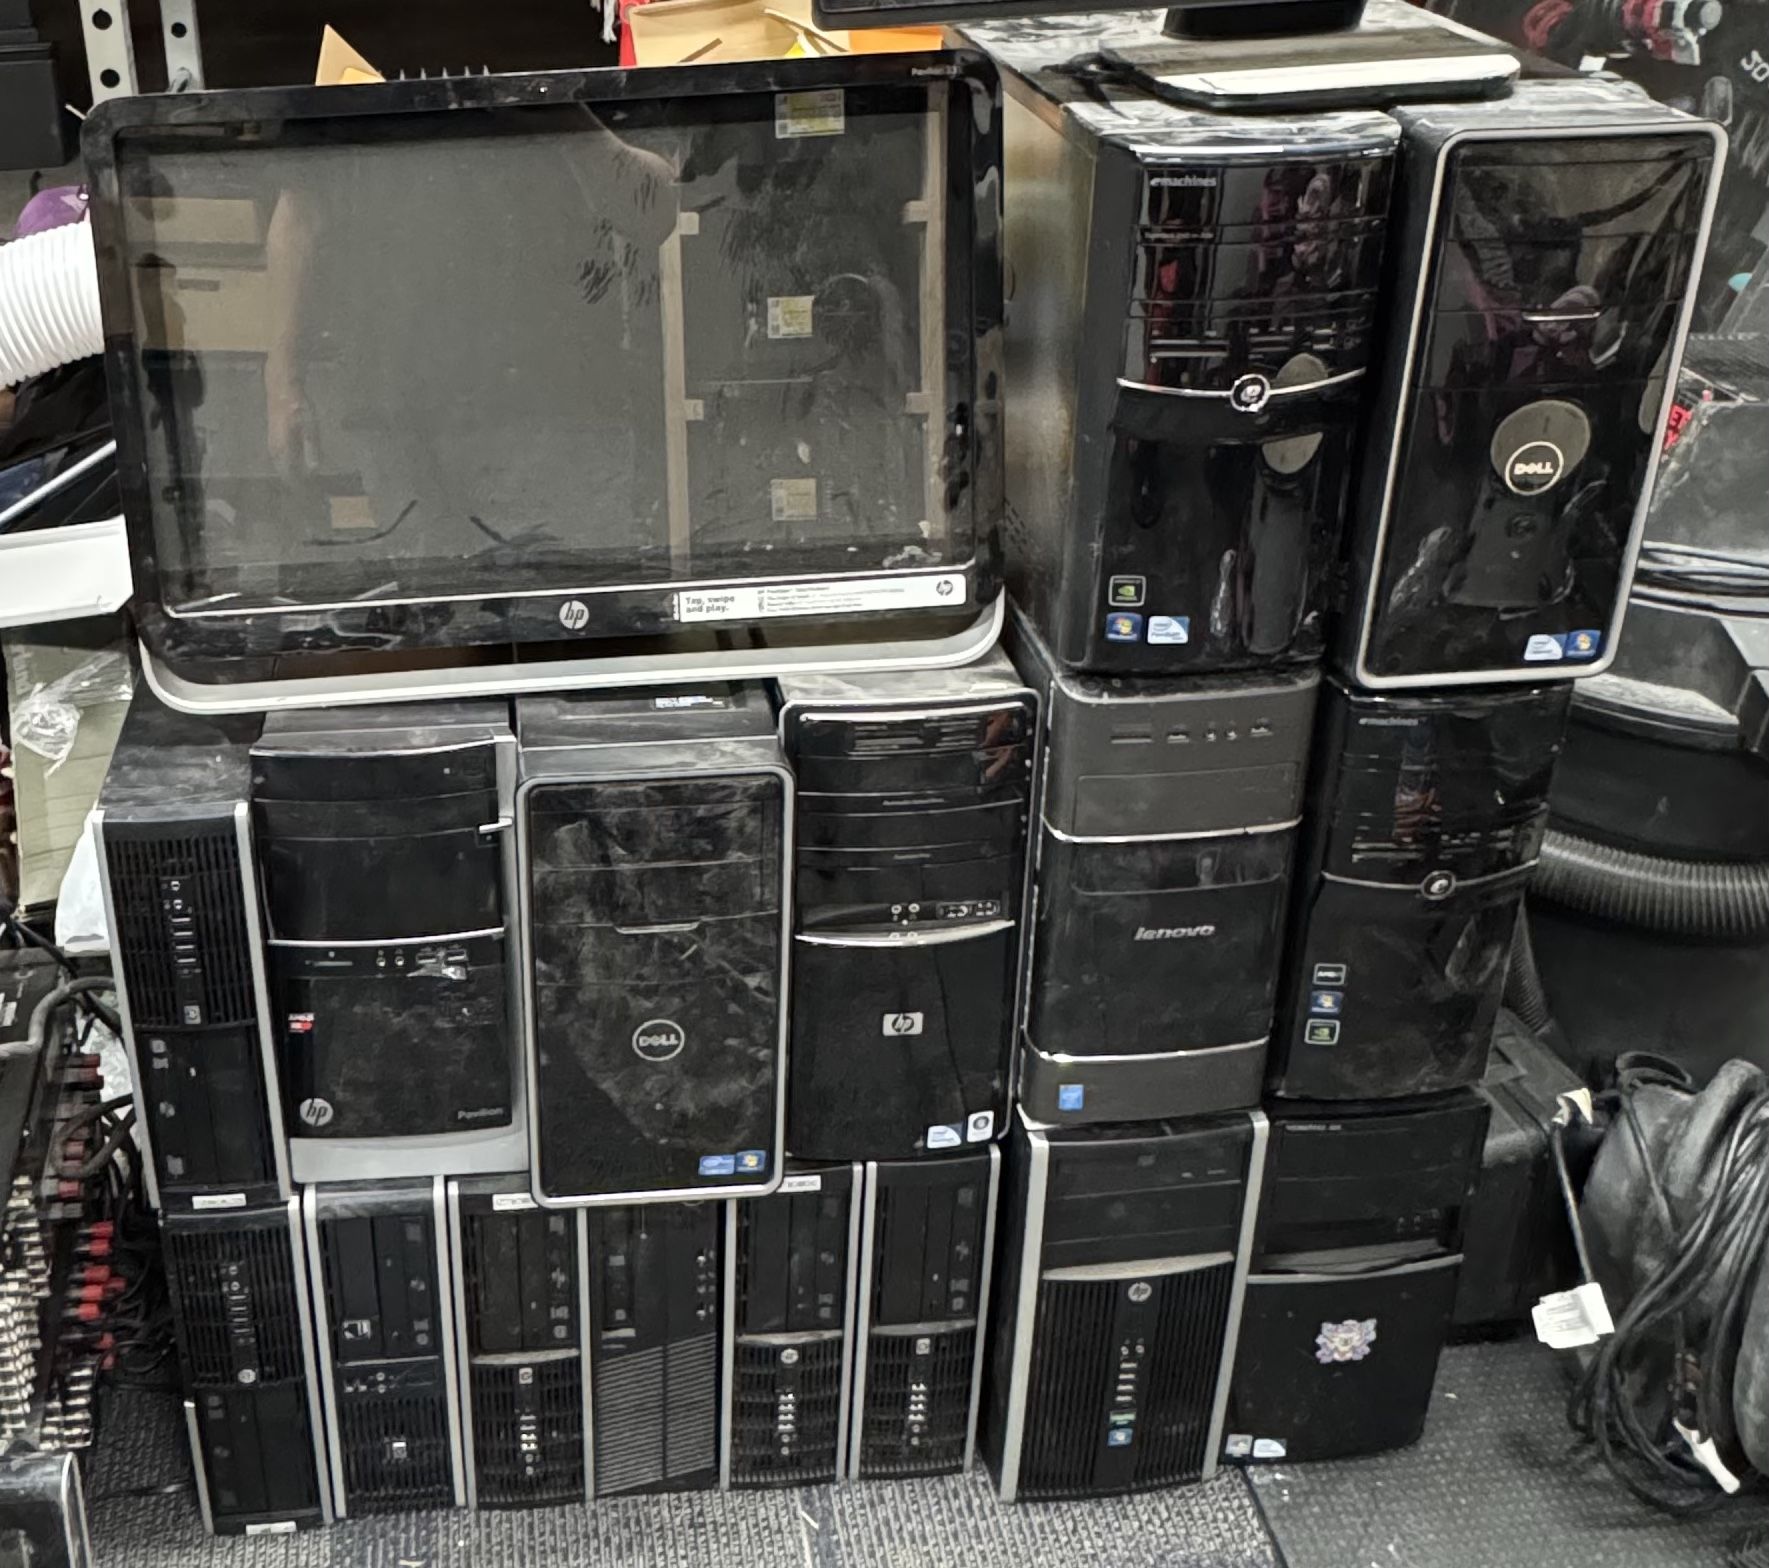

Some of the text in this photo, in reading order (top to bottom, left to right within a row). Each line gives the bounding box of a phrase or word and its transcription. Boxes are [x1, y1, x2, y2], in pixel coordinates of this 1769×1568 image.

[1513, 461, 1554, 475] DELL
[562, 600, 588, 629] hp
[1133, 925, 1216, 941] lenovo
[638, 1033, 679, 1047] DELL
[304, 1098, 330, 1127] hp
